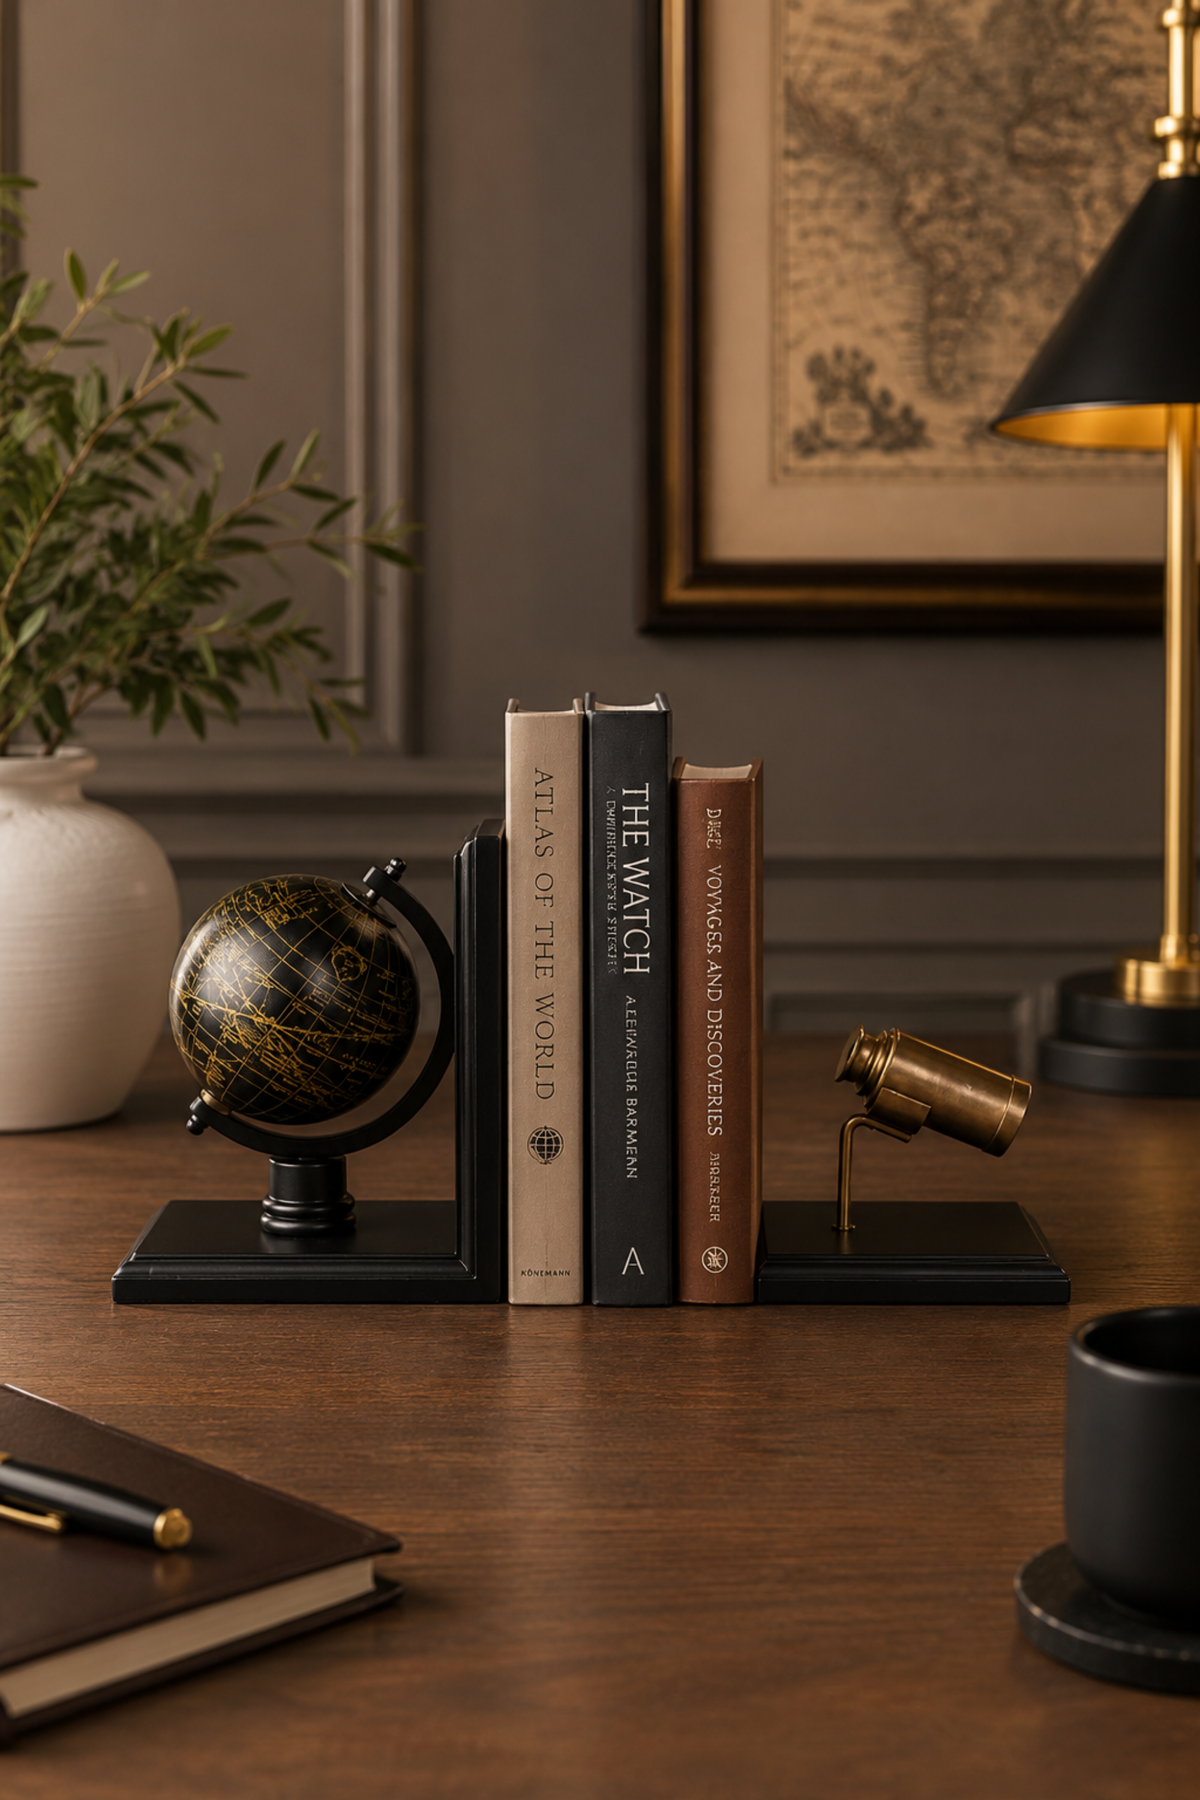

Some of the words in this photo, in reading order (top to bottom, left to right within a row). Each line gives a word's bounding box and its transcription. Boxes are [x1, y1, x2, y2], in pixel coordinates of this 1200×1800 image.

[535, 768, 553, 857] ATLAS
[622, 783, 649, 847] THE
[535, 873, 553, 908] OF
[623, 857, 650, 974] WATCH
[706, 865, 722, 954] VOYAGES
[535, 921, 553, 980] THE
[706, 959, 723, 1002] AND
[535, 993, 554, 1100] WORLD
[621, 1247, 645, 1275] A
